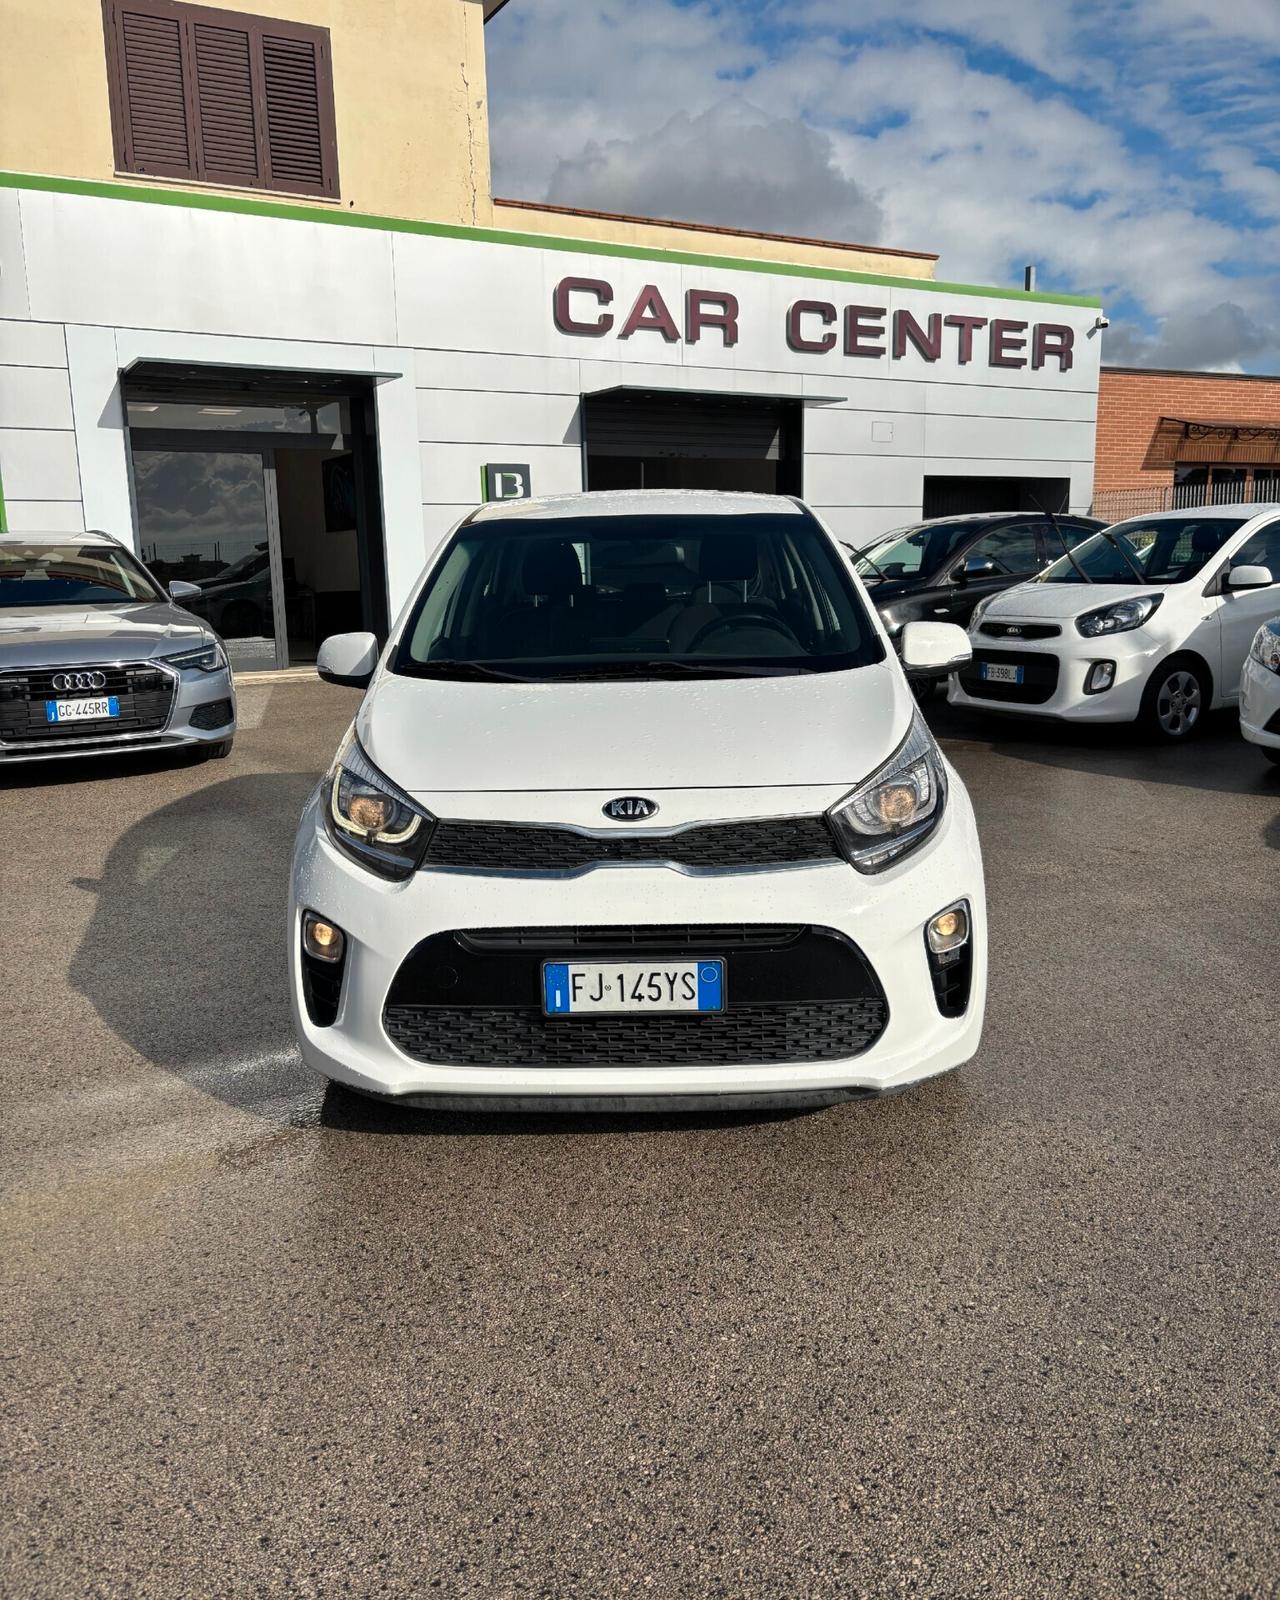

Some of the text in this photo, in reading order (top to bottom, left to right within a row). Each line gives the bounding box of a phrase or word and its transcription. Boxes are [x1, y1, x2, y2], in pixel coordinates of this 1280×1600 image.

[553, 276, 1074, 372] CAR CENTER
[611, 800, 649, 815] KIA
